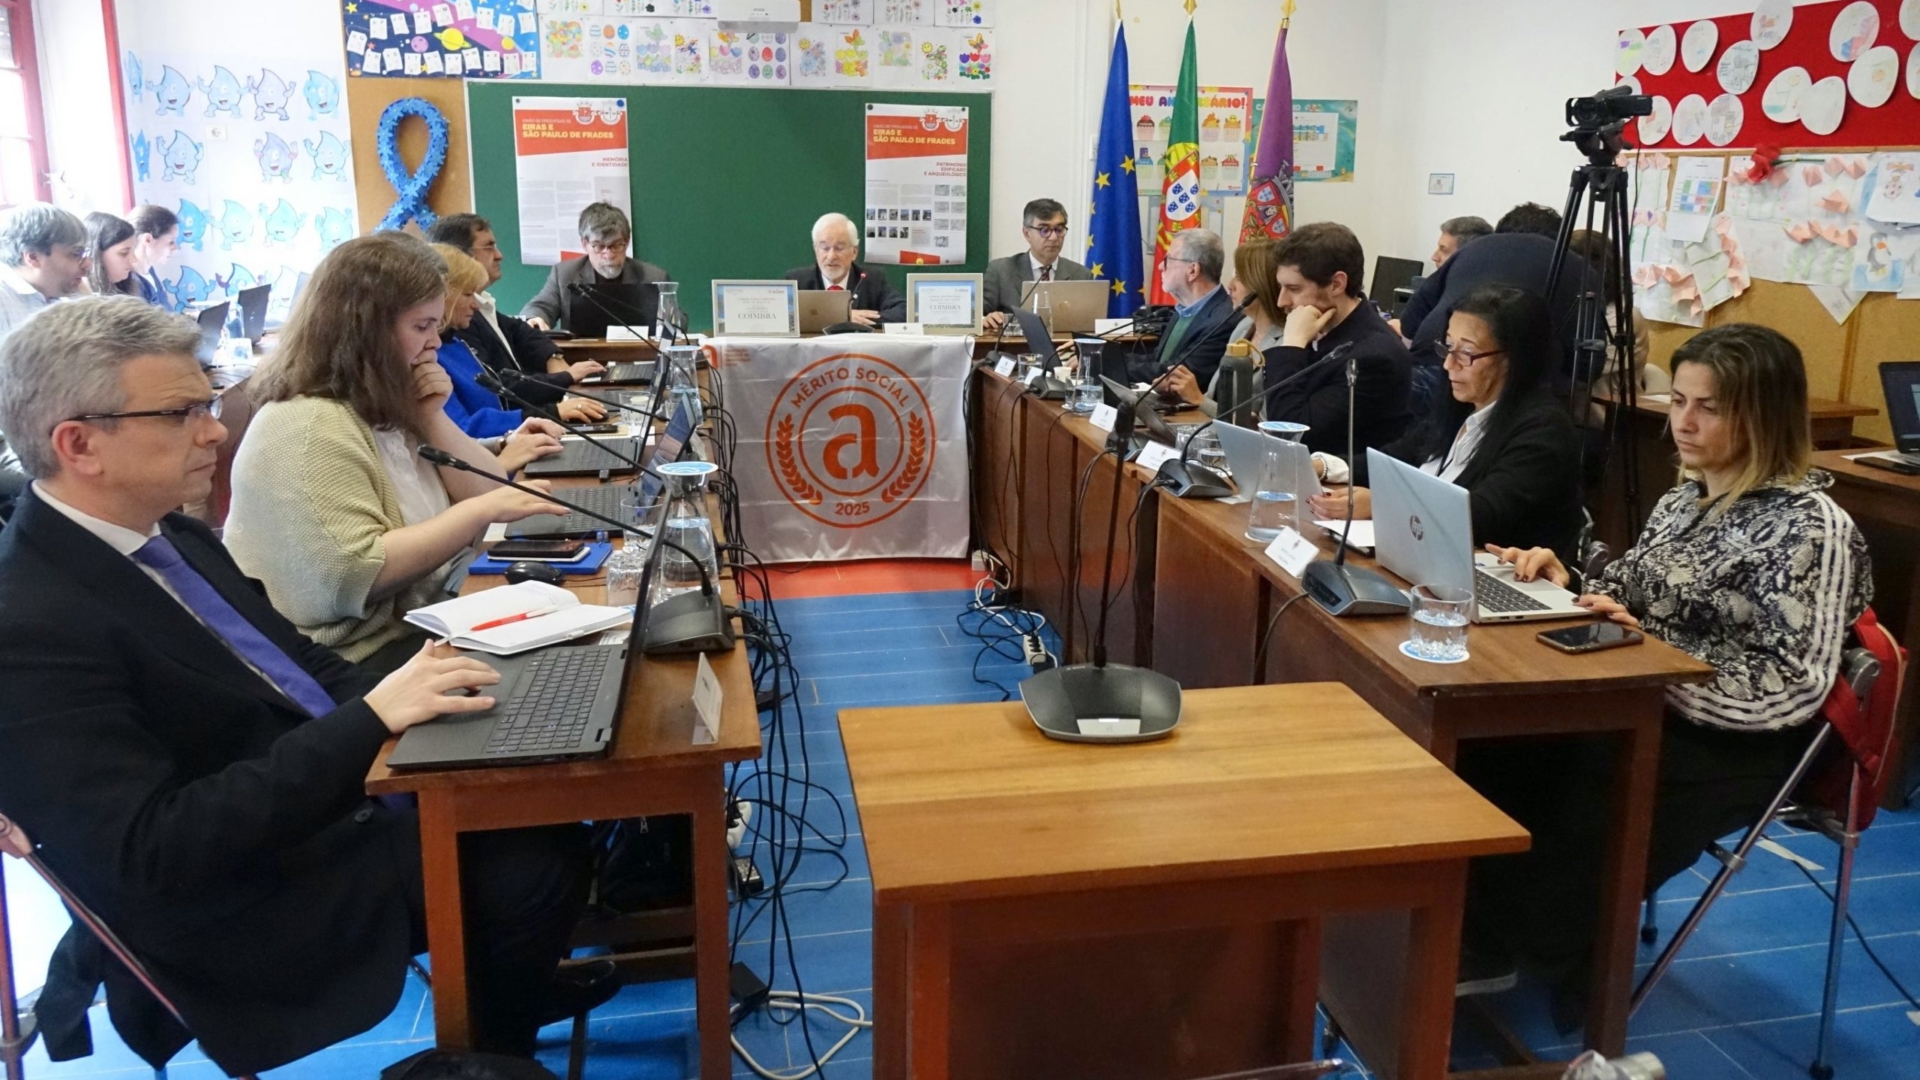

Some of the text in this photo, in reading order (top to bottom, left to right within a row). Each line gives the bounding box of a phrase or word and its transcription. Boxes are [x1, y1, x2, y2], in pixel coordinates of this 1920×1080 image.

[1129, 95, 1154, 107] MEU
[523, 130, 539, 138] SÃO
[791, 367, 908, 409] MÉRITO SOCIAL
[823, 403, 880, 480] a
[834, 501, 870, 516] 2025
